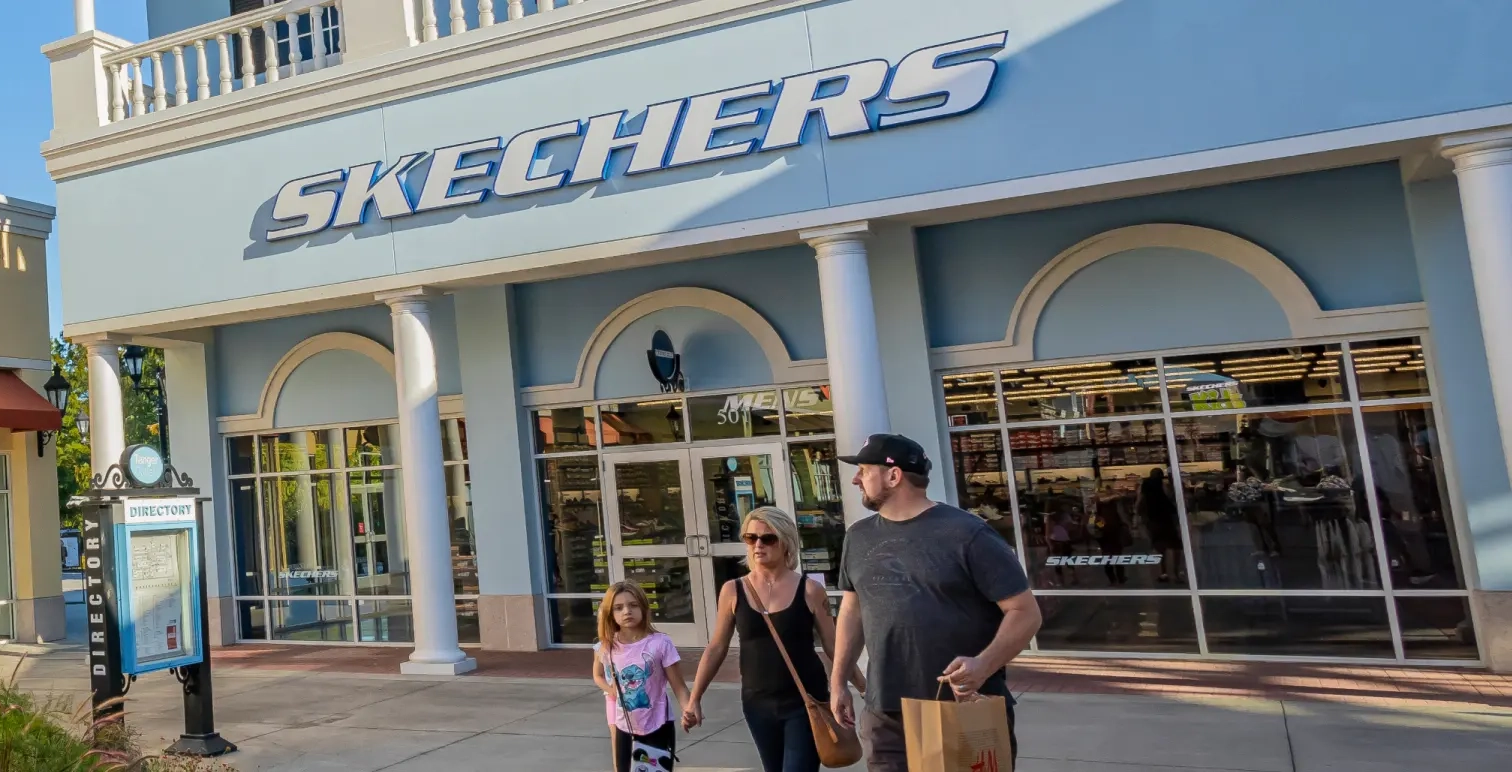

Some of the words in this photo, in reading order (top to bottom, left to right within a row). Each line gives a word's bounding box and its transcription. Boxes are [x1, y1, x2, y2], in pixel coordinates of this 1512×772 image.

[265, 29, 1009, 243] SKECHERS
[130, 505, 192, 517] DIRECTORY
[1045, 554, 1163, 566] SKECHERS
[278, 570, 339, 579] SKECHERS
[85, 519, 107, 676] DIRECTORY
